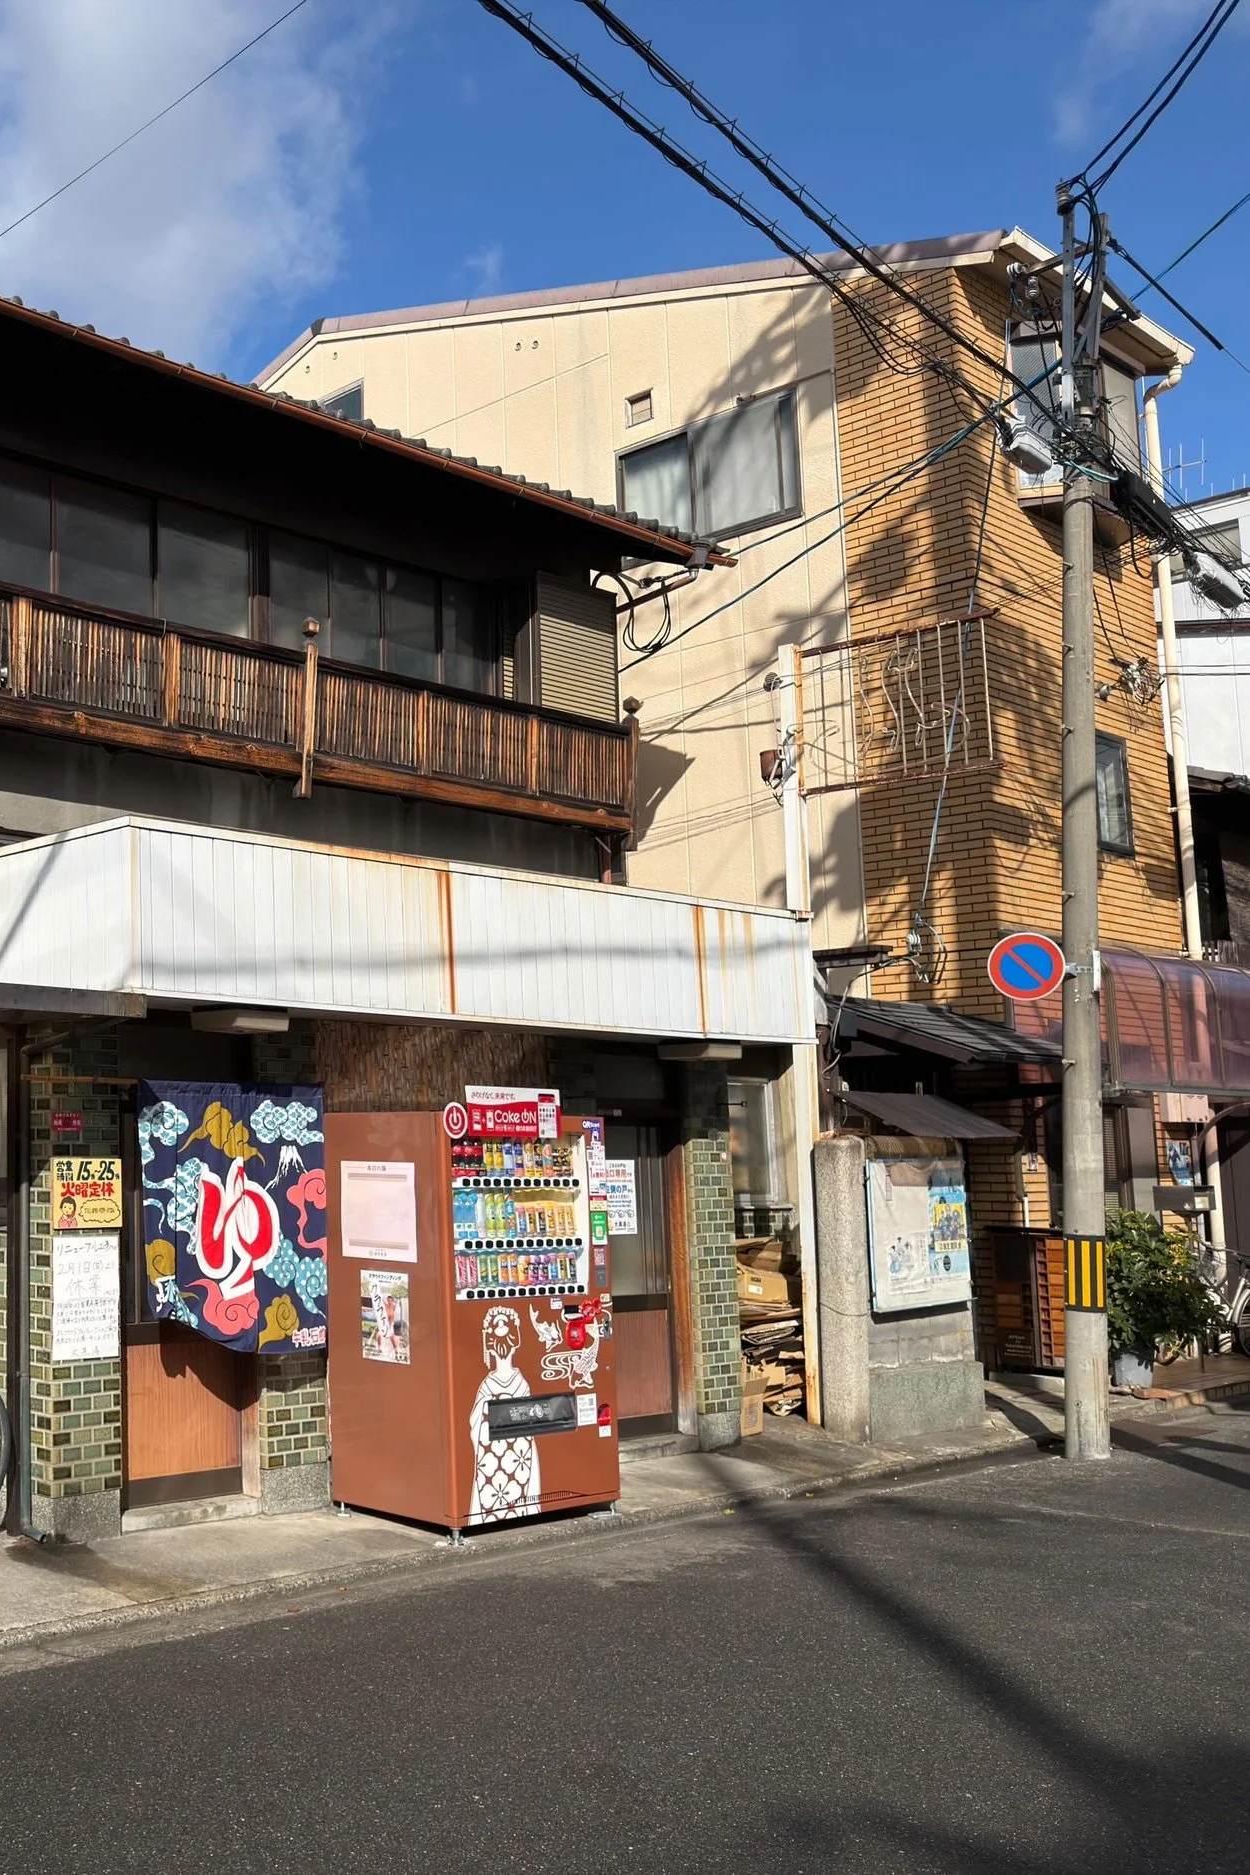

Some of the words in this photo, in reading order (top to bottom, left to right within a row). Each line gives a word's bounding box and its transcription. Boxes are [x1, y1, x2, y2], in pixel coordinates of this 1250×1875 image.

[494, 1109, 521, 1123] Coke
[60, 1181, 115, 1198] 火曜定休
[197, 1157, 280, 1300] ゆ
